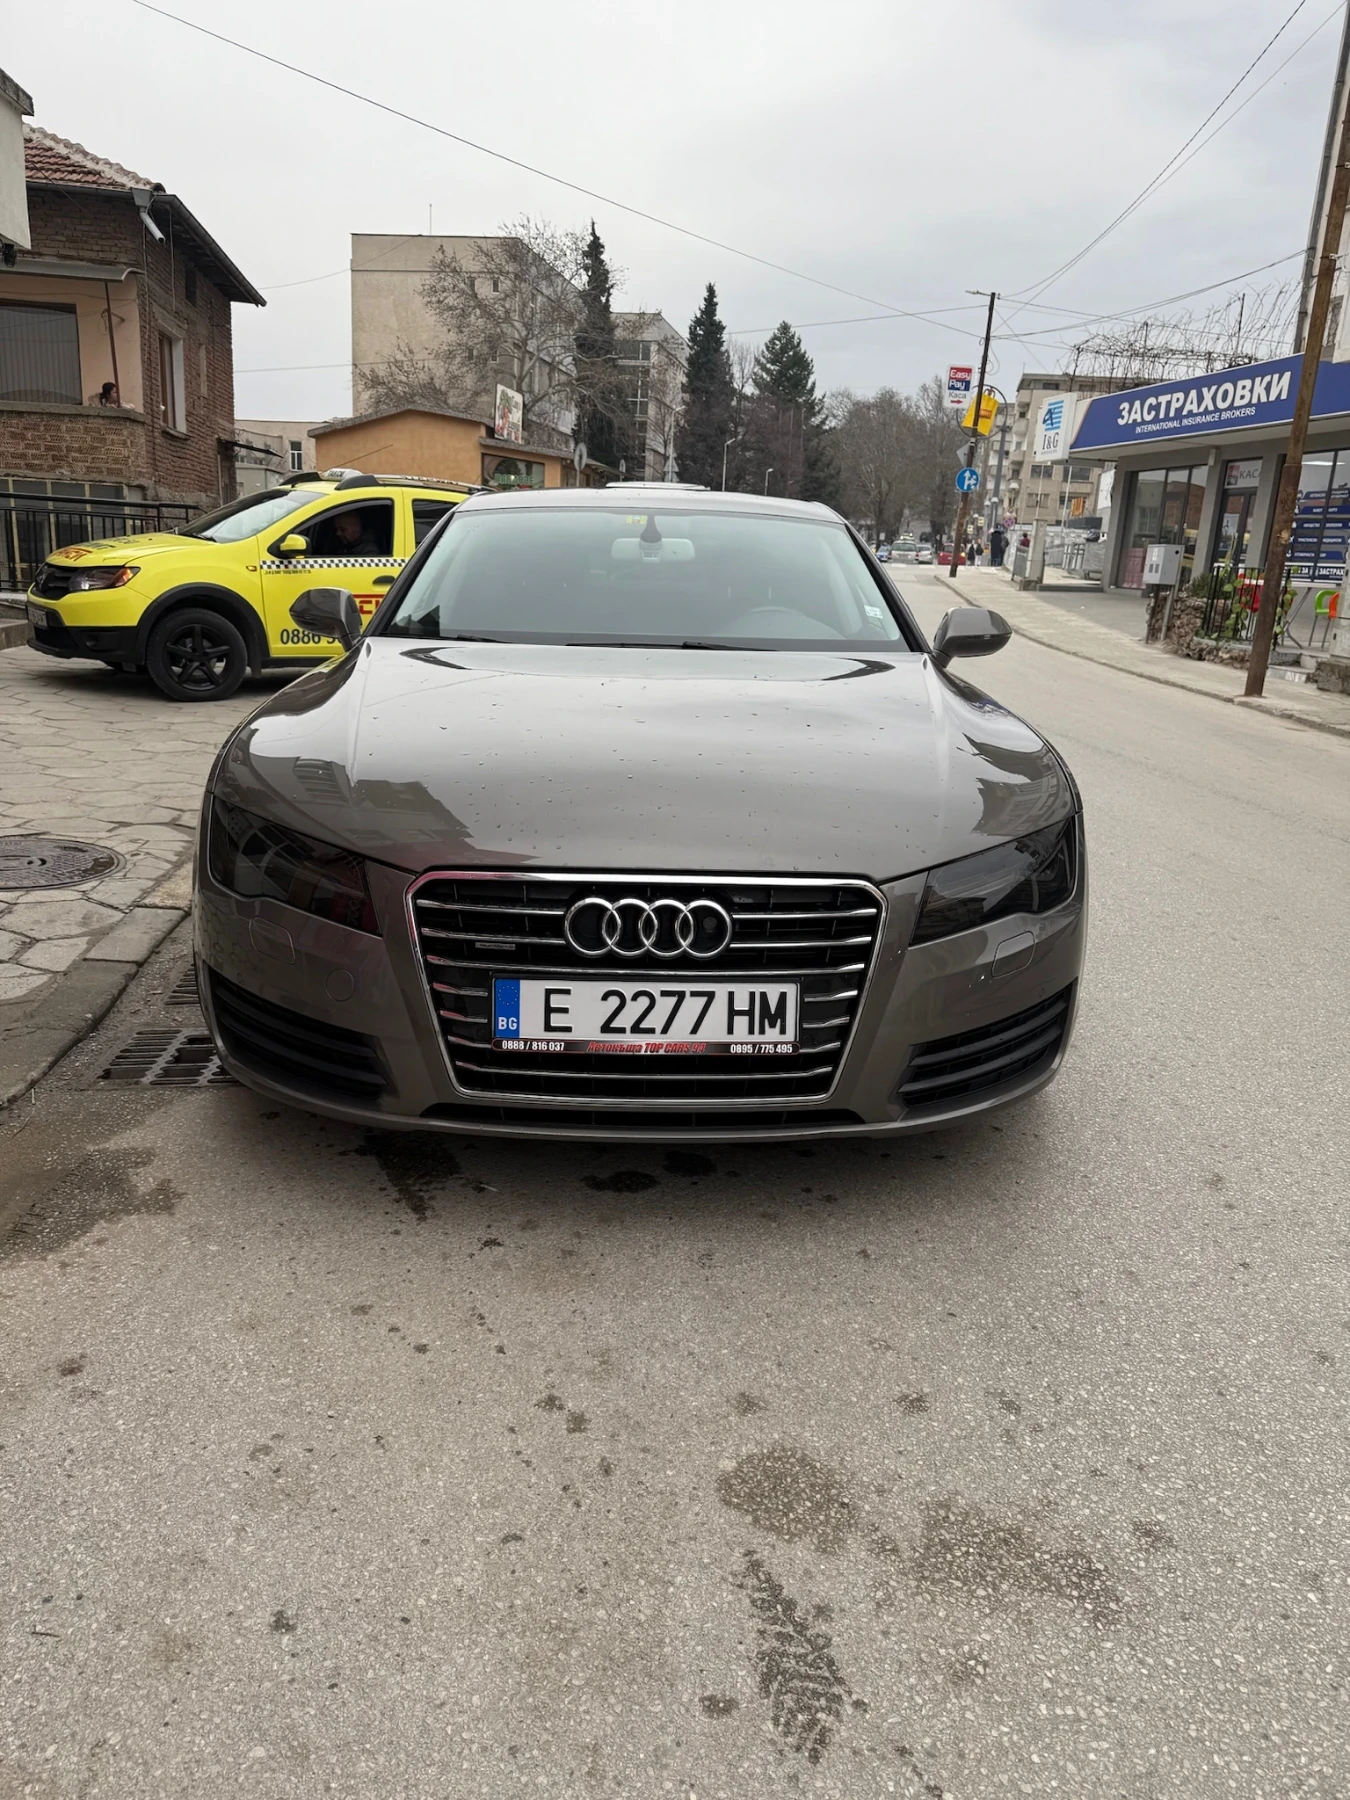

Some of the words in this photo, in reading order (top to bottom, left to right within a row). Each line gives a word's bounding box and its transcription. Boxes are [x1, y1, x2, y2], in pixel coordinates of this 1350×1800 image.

[950, 369, 972, 380] Easy
[948, 380, 966, 390] Pay
[948, 391, 967, 399] Каса
[1117, 371, 1292, 426] ЗАСТРАХОВКИ
[1135, 418, 1181, 434] INTERNATIONAL
[1181, 412, 1220, 426] INSURANCE
[1220, 406, 1256, 420] BROKERS
[1042, 432, 1060, 450] I&G
[544, 986, 573, 1033] E
[600, 989, 716, 1035] 2277
[727, 990, 788, 1036] HM
[498, 1017, 518, 1030] BG
[502, 1040, 524, 1050] 0888
[532, 1041, 547, 1051] 816
[549, 1042, 565, 1051] 037
[588, 1041, 642, 1053] Автокъща
[644, 1042, 664, 1053] TOP
[664, 1043, 690, 1053] CARS
[730, 1044, 752, 1053] 0895
[761, 1044, 774, 1053] 775
[776, 1044, 792, 1053] 495
